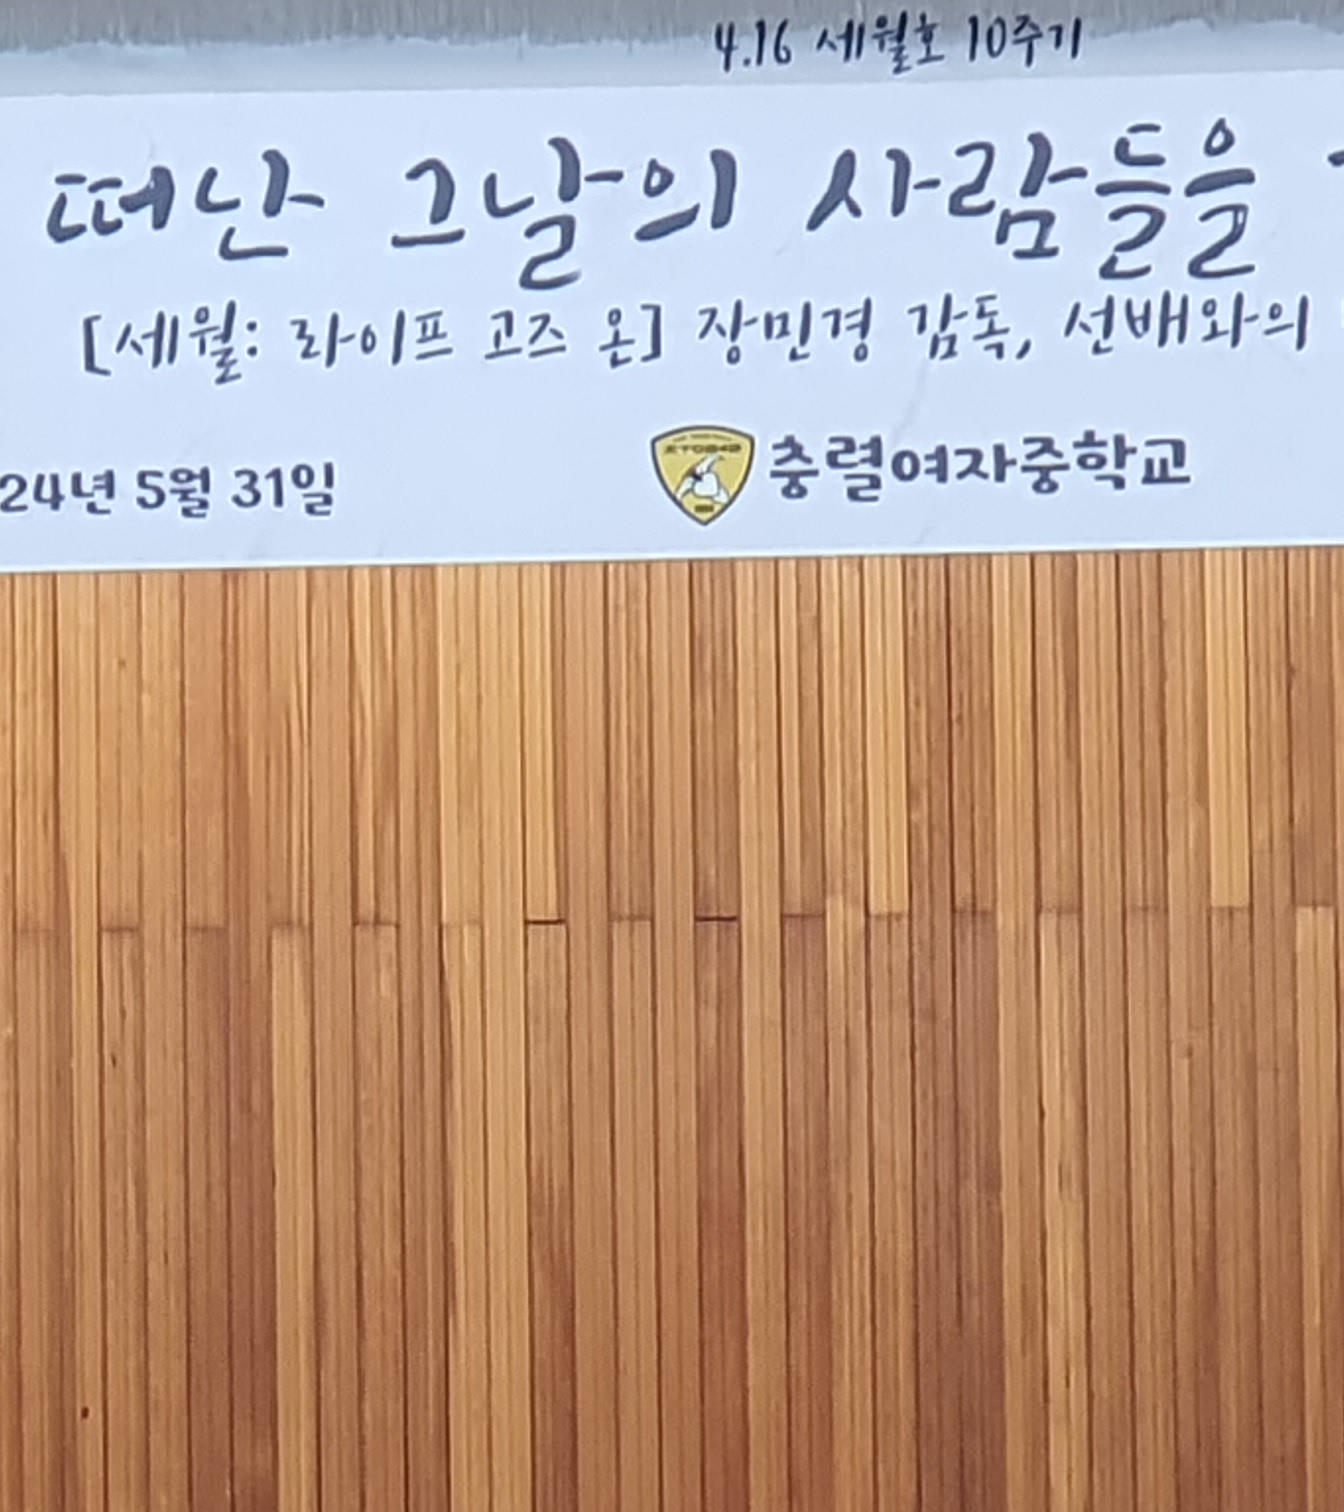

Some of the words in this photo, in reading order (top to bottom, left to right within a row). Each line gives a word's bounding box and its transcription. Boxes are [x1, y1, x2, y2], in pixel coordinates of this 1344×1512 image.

[714, 17, 792, 72] 4.16
[816, 9, 945, 75] 세월호
[967, 13, 1083, 67] 10주기
[46, 148, 325, 262] 떠난
[390, 136, 738, 292] 그날의
[805, 117, 1256, 281] 사람들을
[82, 299, 258, 386] [세월:
[289, 309, 454, 369] 라이프
[484, 309, 567, 361] 고즈
[598, 303, 662, 370] 온]
[698, 296, 873, 366] 장민경
[907, 292, 1032, 361] 감독,
[1063, 288, 1309, 356] 선배와의
[135, 465, 211, 519] 5월
[231, 461, 335, 517] 31일
[769, 429, 1192, 503] 충렬여자중학교
